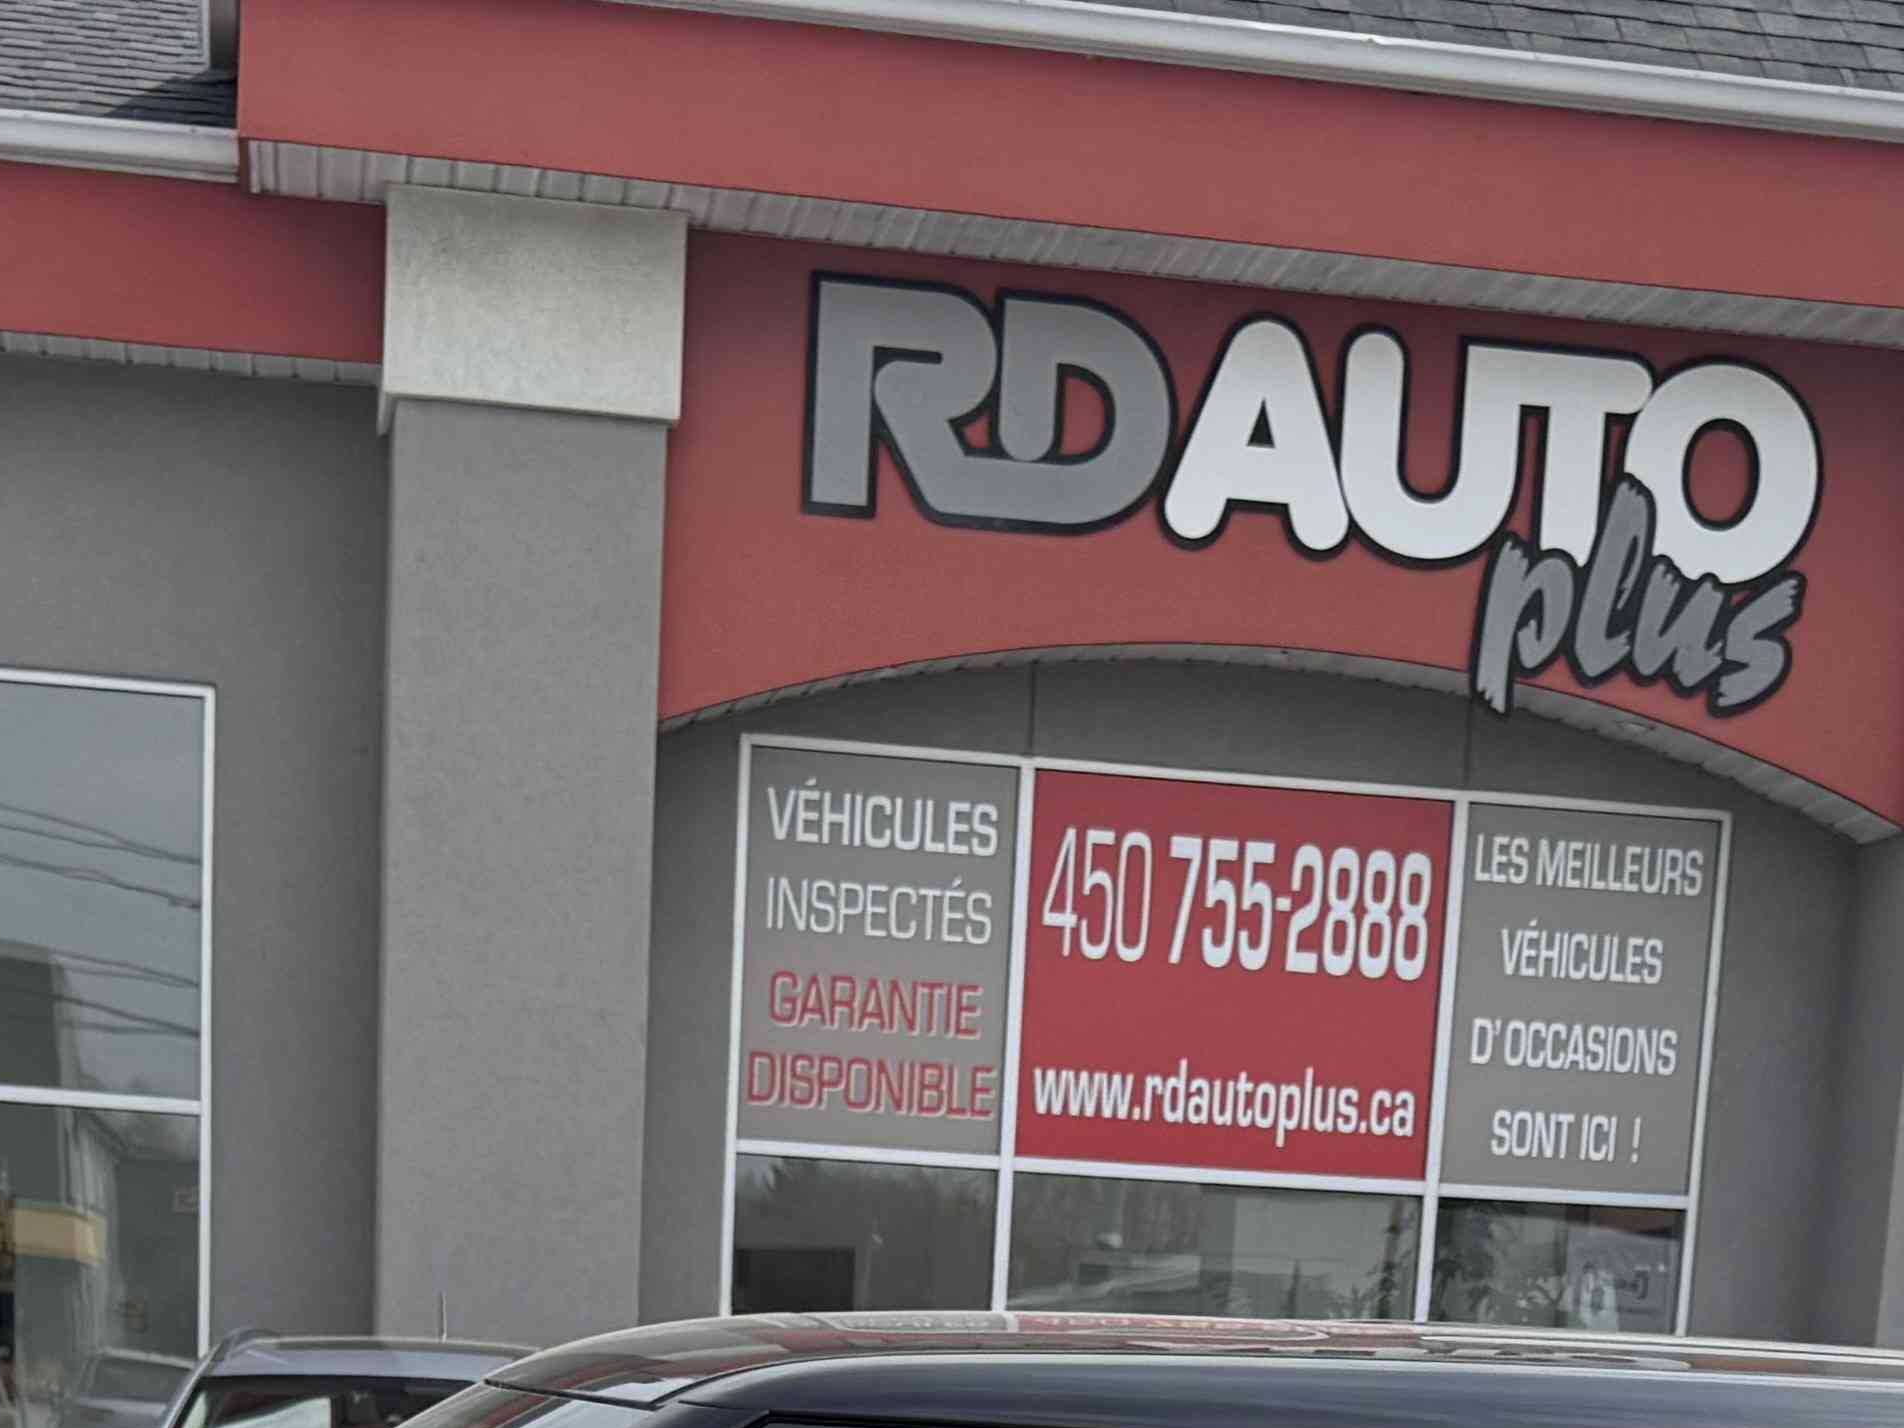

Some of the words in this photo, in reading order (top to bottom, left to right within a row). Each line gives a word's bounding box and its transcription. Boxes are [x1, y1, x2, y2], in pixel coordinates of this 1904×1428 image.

[1472, 472, 1807, 718] plus
[767, 777, 999, 857] VÉHICULES
[1474, 834, 1529, 885] LES
[1536, 838, 1704, 897] MEILLEURS
[766, 876, 993, 945] INSPECTÉS
[1042, 827, 1153, 963] 450
[1168, 835, 1432, 981] 755-2888
[1501, 918, 1664, 984] VÉHICULES
[769, 970, 985, 1041] GARANTIE
[748, 1051, 997, 1121] DISPONIBLE
[1034, 1058, 1417, 1148] www.rdautoplus.ca
[1491, 1109, 1576, 1160] SONT
[1579, 1114, 1618, 1163] ICI
